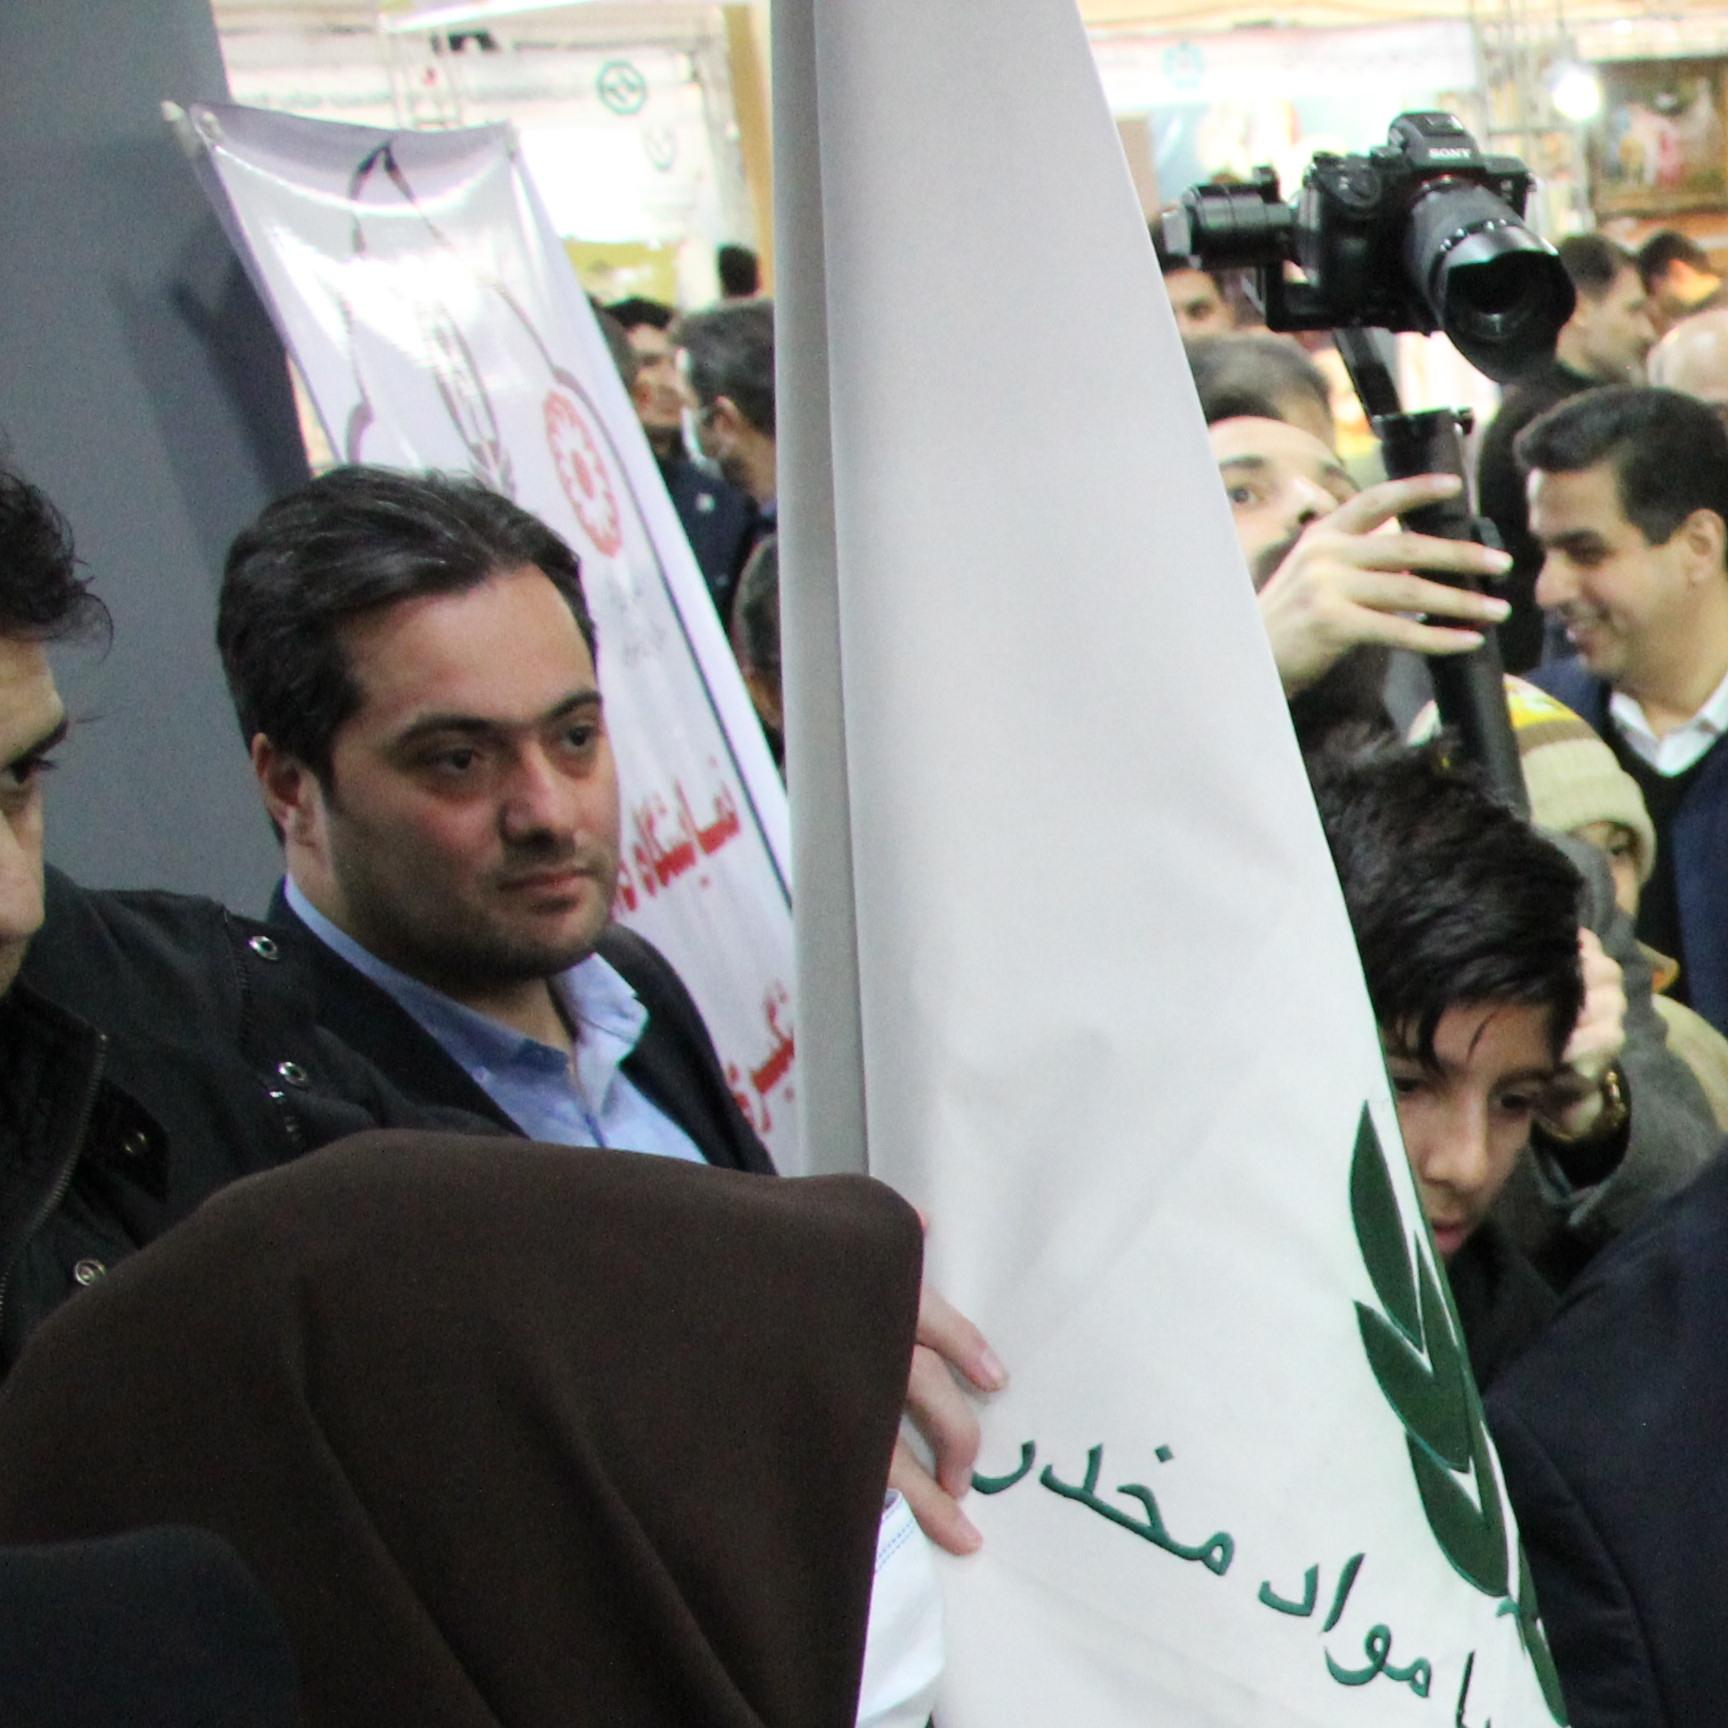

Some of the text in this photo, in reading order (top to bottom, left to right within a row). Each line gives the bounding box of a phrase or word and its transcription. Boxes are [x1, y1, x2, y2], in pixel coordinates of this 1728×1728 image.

[1427, 147, 1471, 160] SONY
[970, 1439, 1237, 1577] مخدر
[1257, 1552, 1434, 1699] مواد
